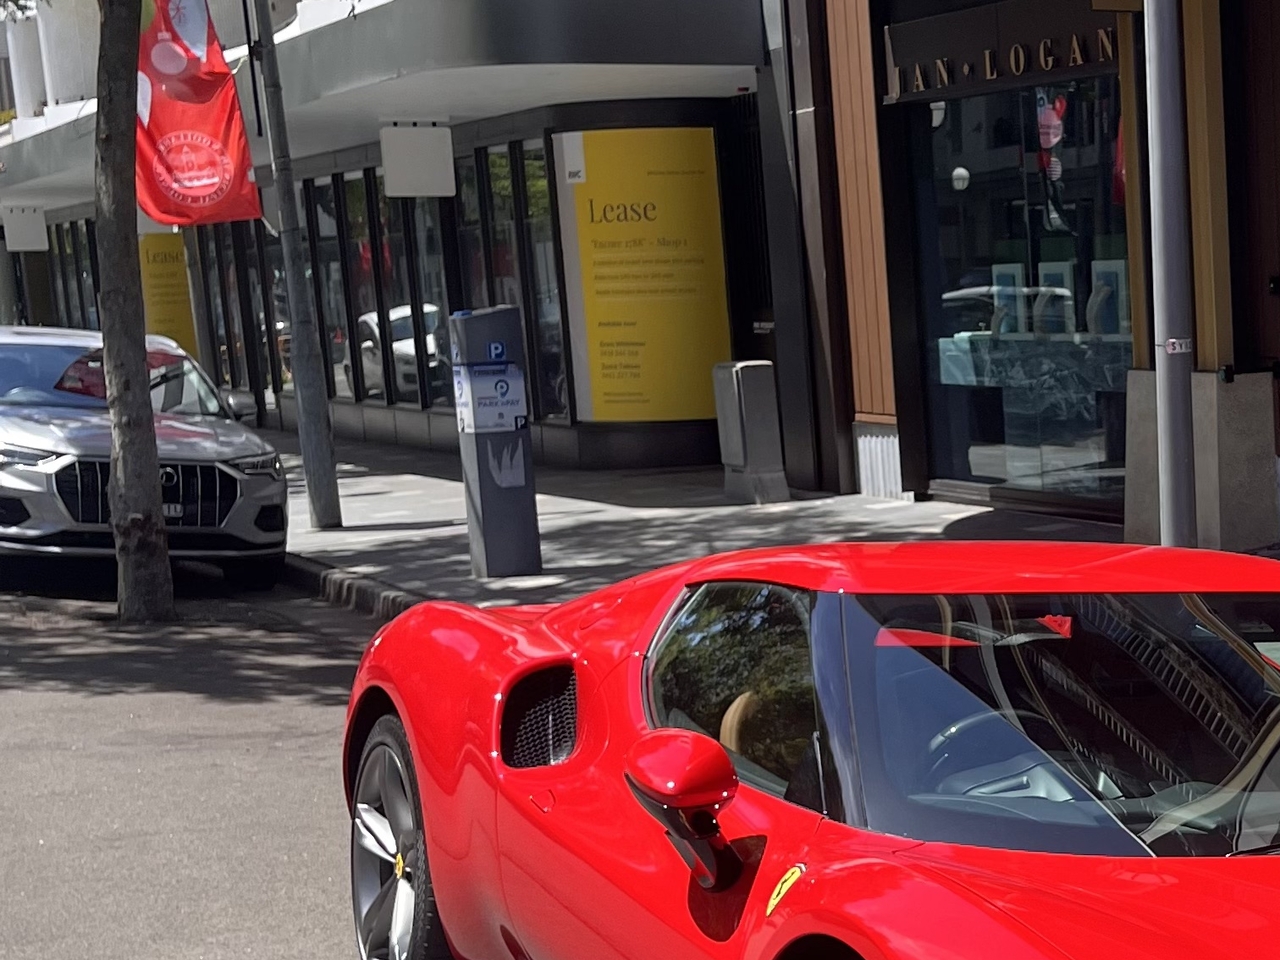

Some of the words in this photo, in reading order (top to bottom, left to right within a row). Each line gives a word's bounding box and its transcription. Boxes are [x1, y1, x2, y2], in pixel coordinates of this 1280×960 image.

[983, 27, 1113, 81] LOGAN
[588, 198, 658, 225] Lease
[490, 342, 502, 359] P
